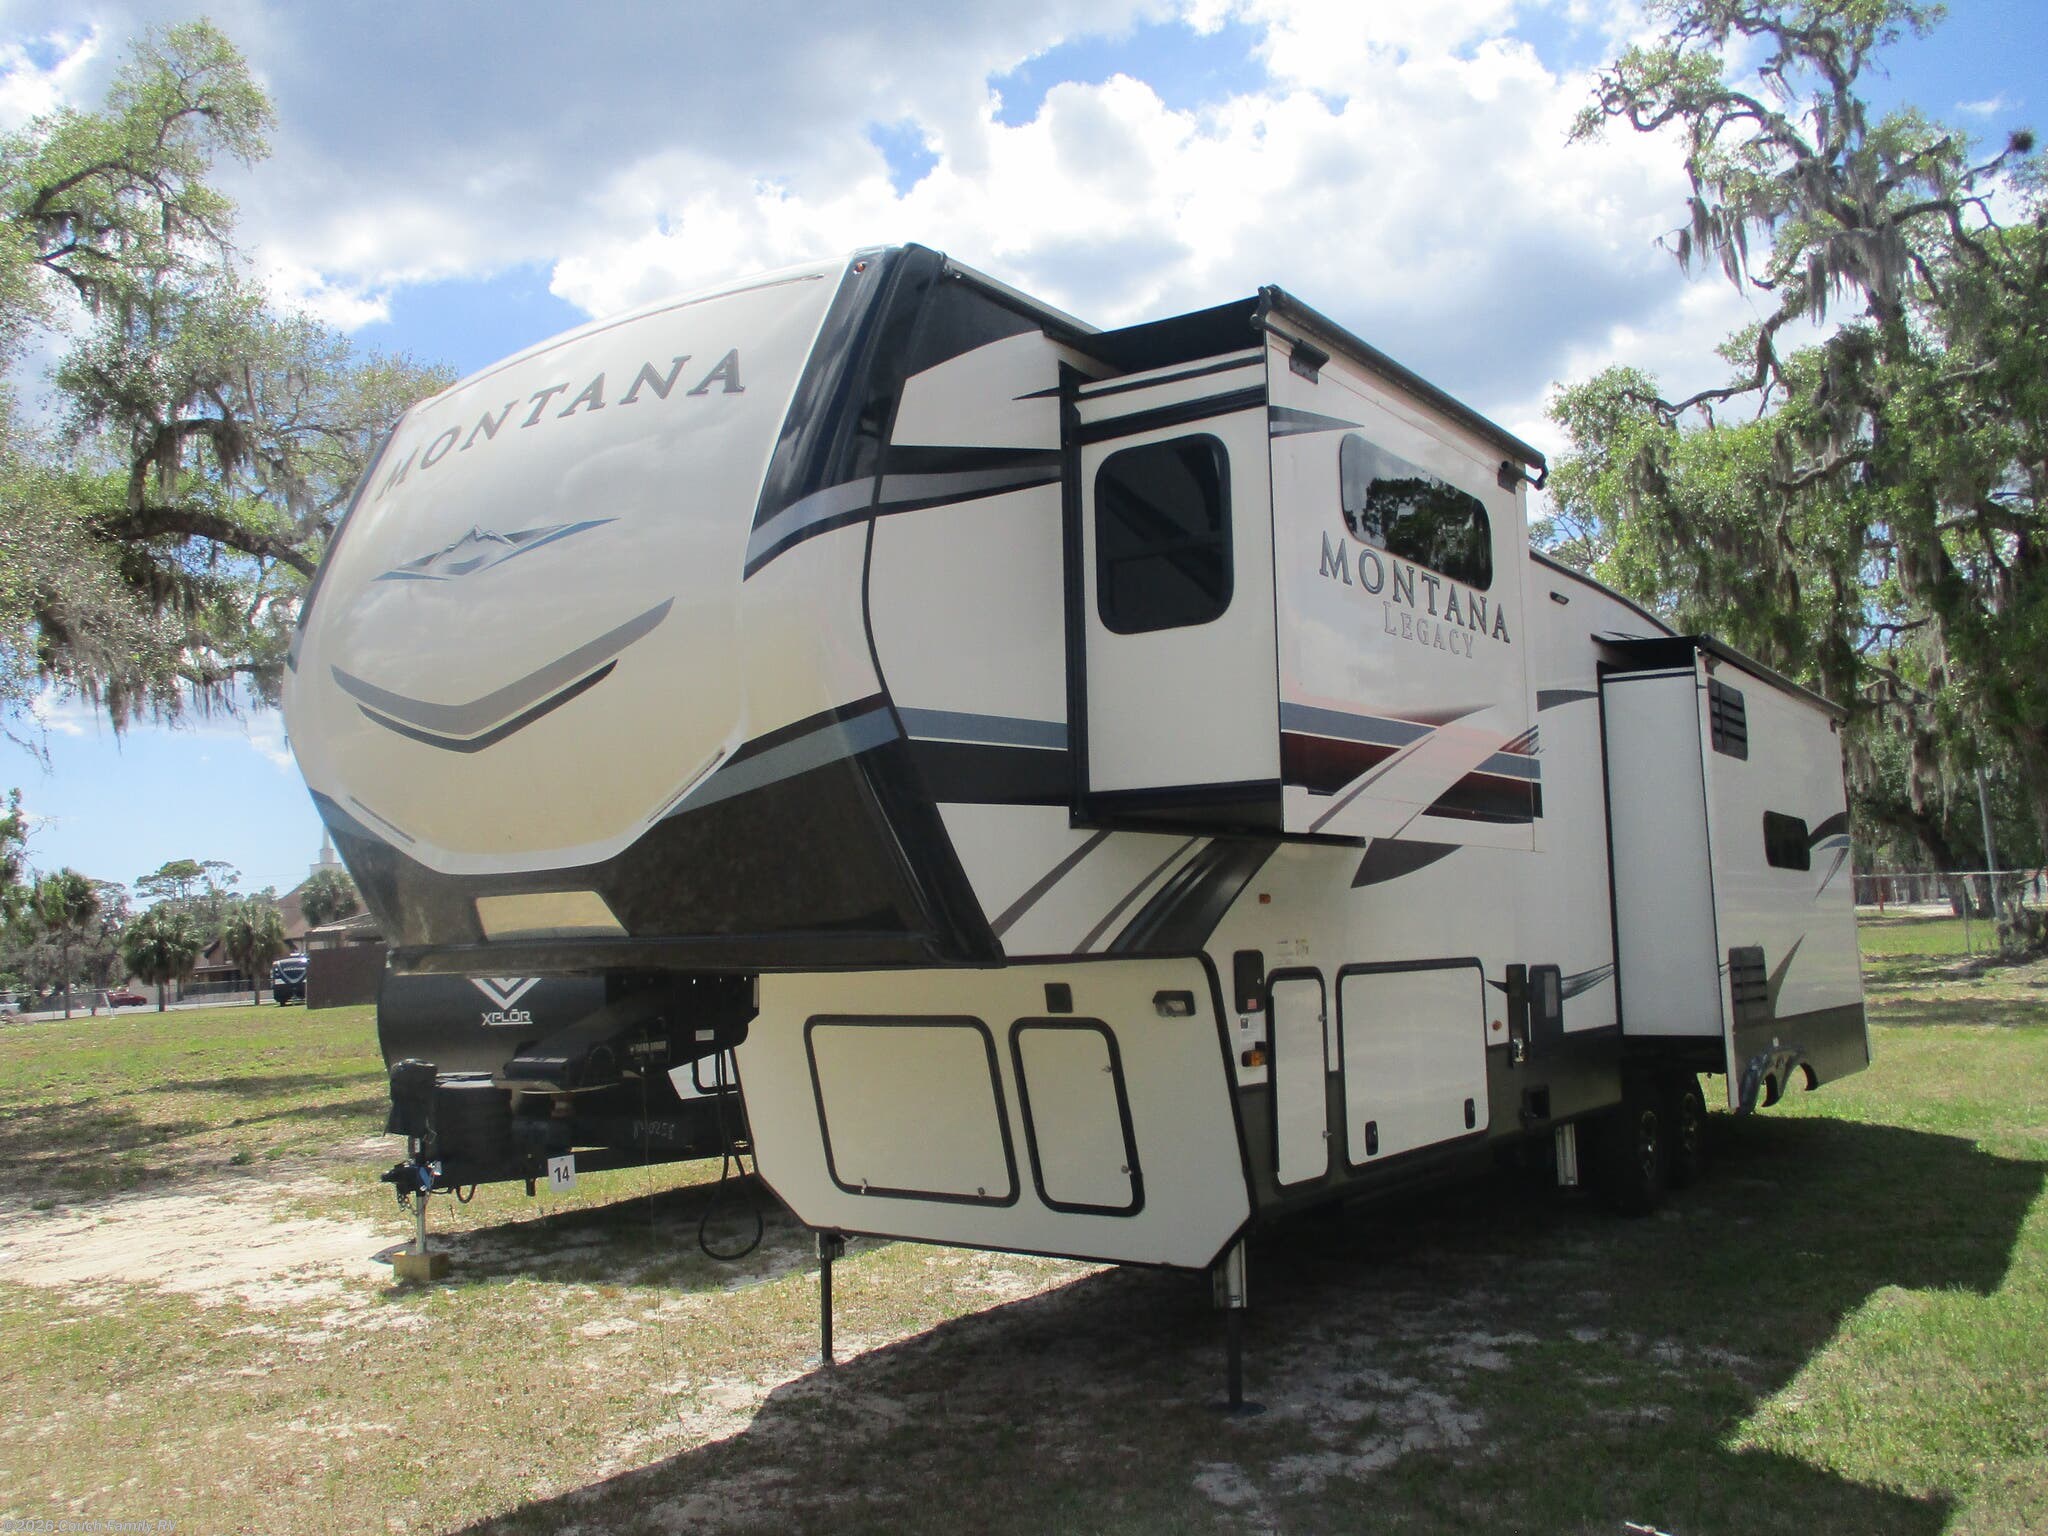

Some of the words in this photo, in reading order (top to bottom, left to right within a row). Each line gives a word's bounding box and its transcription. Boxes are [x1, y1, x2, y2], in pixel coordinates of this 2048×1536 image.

[376, 347, 746, 502] MONTANA
[1318, 529, 1511, 644] MONTANA
[1382, 600, 1474, 659] LEGACY
[554, 1165, 570, 1182] 14
